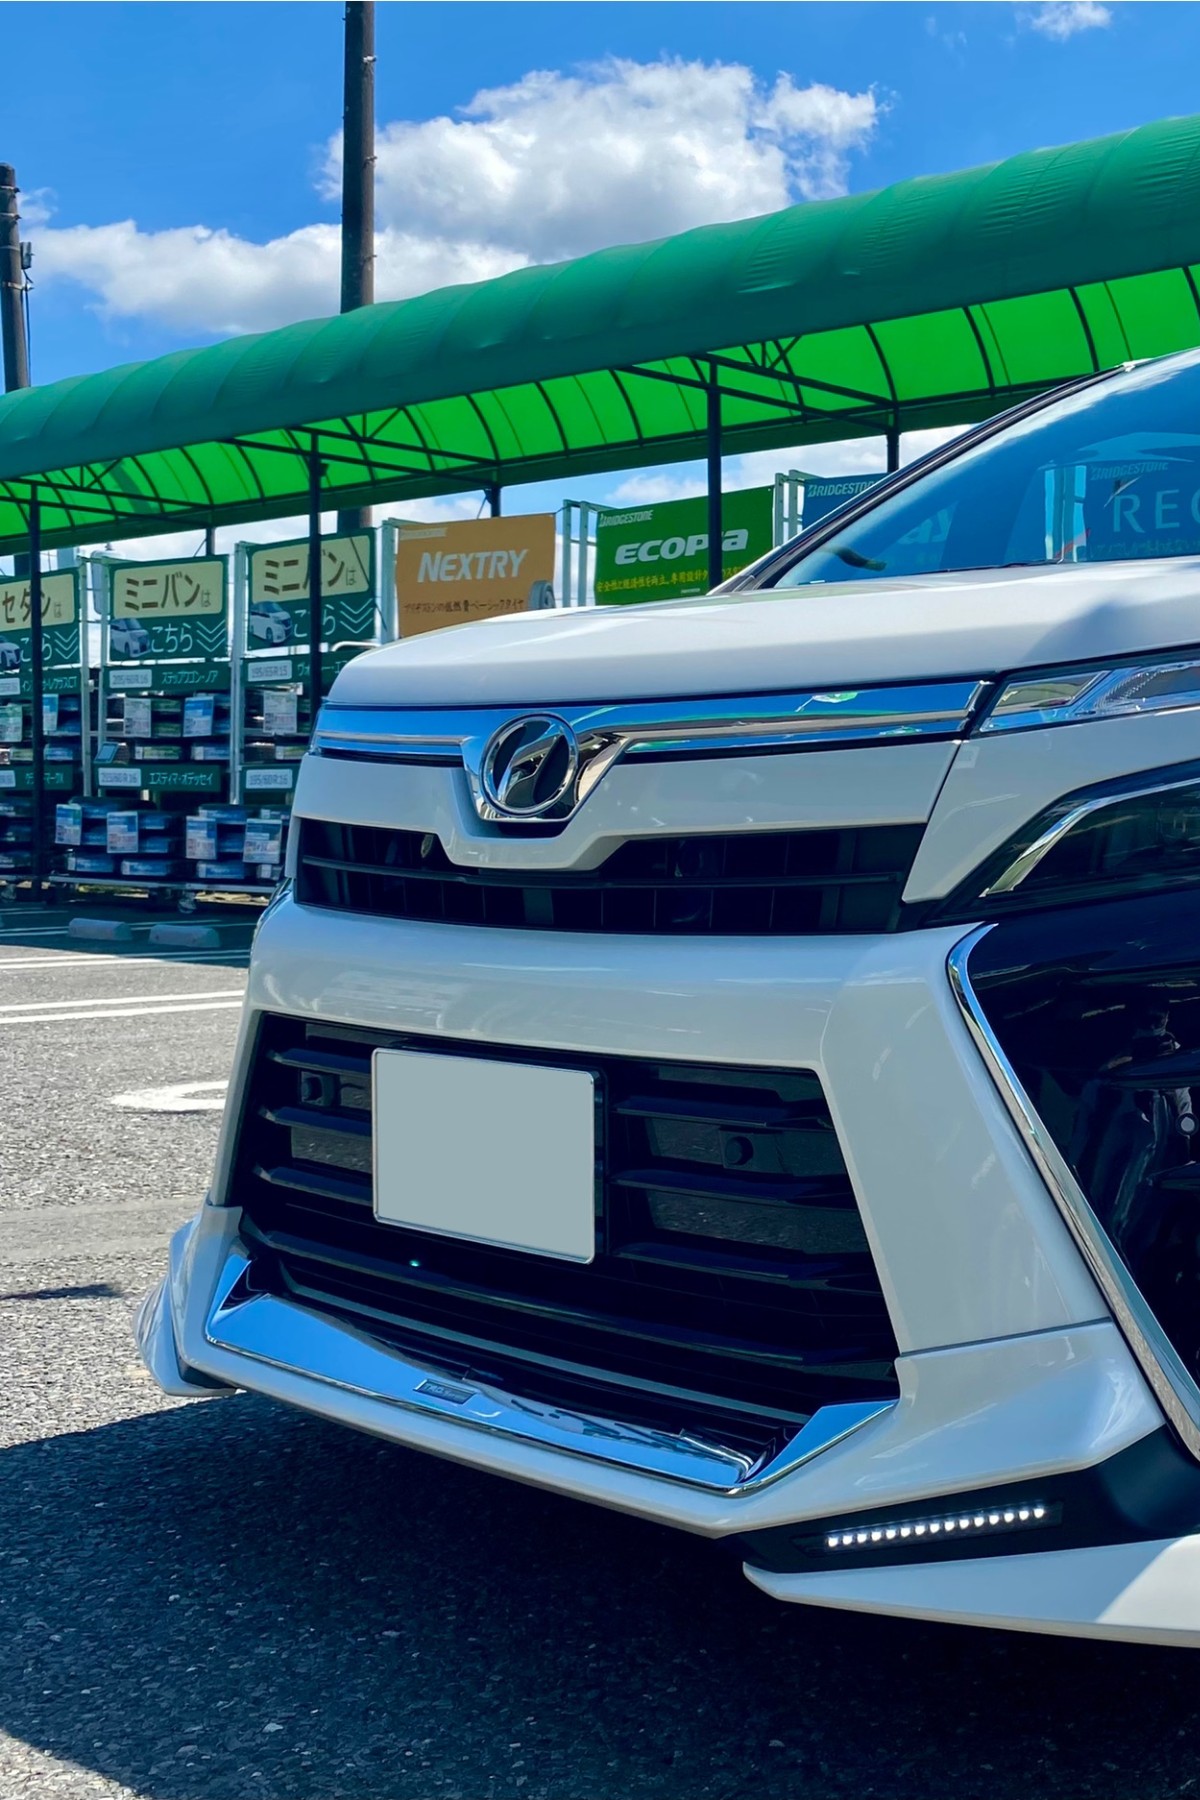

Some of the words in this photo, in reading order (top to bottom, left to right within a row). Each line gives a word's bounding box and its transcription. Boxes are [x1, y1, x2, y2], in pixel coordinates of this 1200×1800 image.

[416, 548, 529, 583] NEXTRY
[124, 571, 212, 612] ミニバンは
[151, 622, 194, 653] こちら
[293, 604, 337, 638] こら
[20, 632, 52, 663] こら
